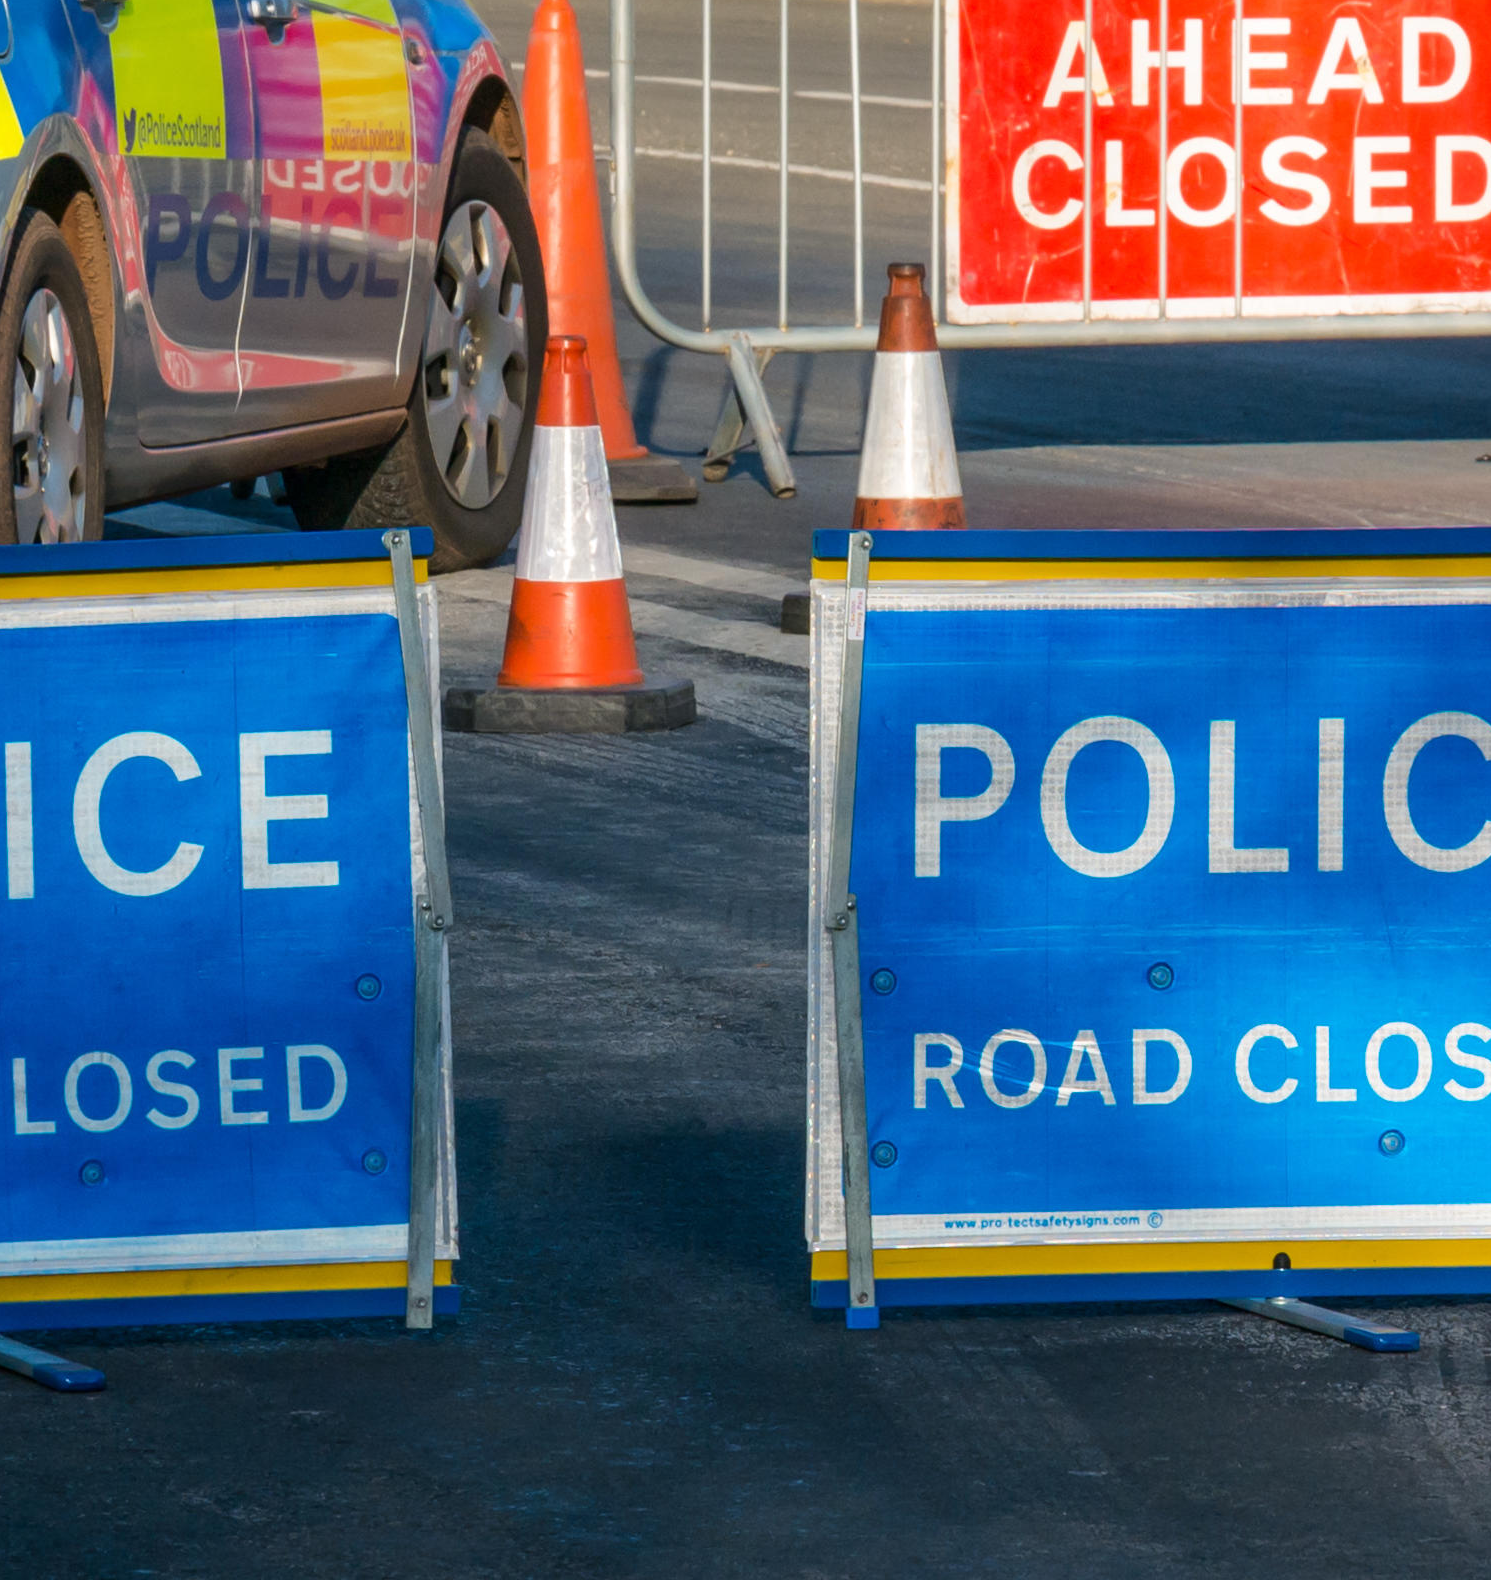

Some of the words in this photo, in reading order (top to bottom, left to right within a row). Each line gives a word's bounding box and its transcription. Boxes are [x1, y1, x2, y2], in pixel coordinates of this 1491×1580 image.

[1042, 17, 1472, 107] AHEAD
[138, 112, 221, 150] @PoliceScotland
[146, 192, 404, 301] POLICE
[913, 1028, 1193, 1110] ROAD
